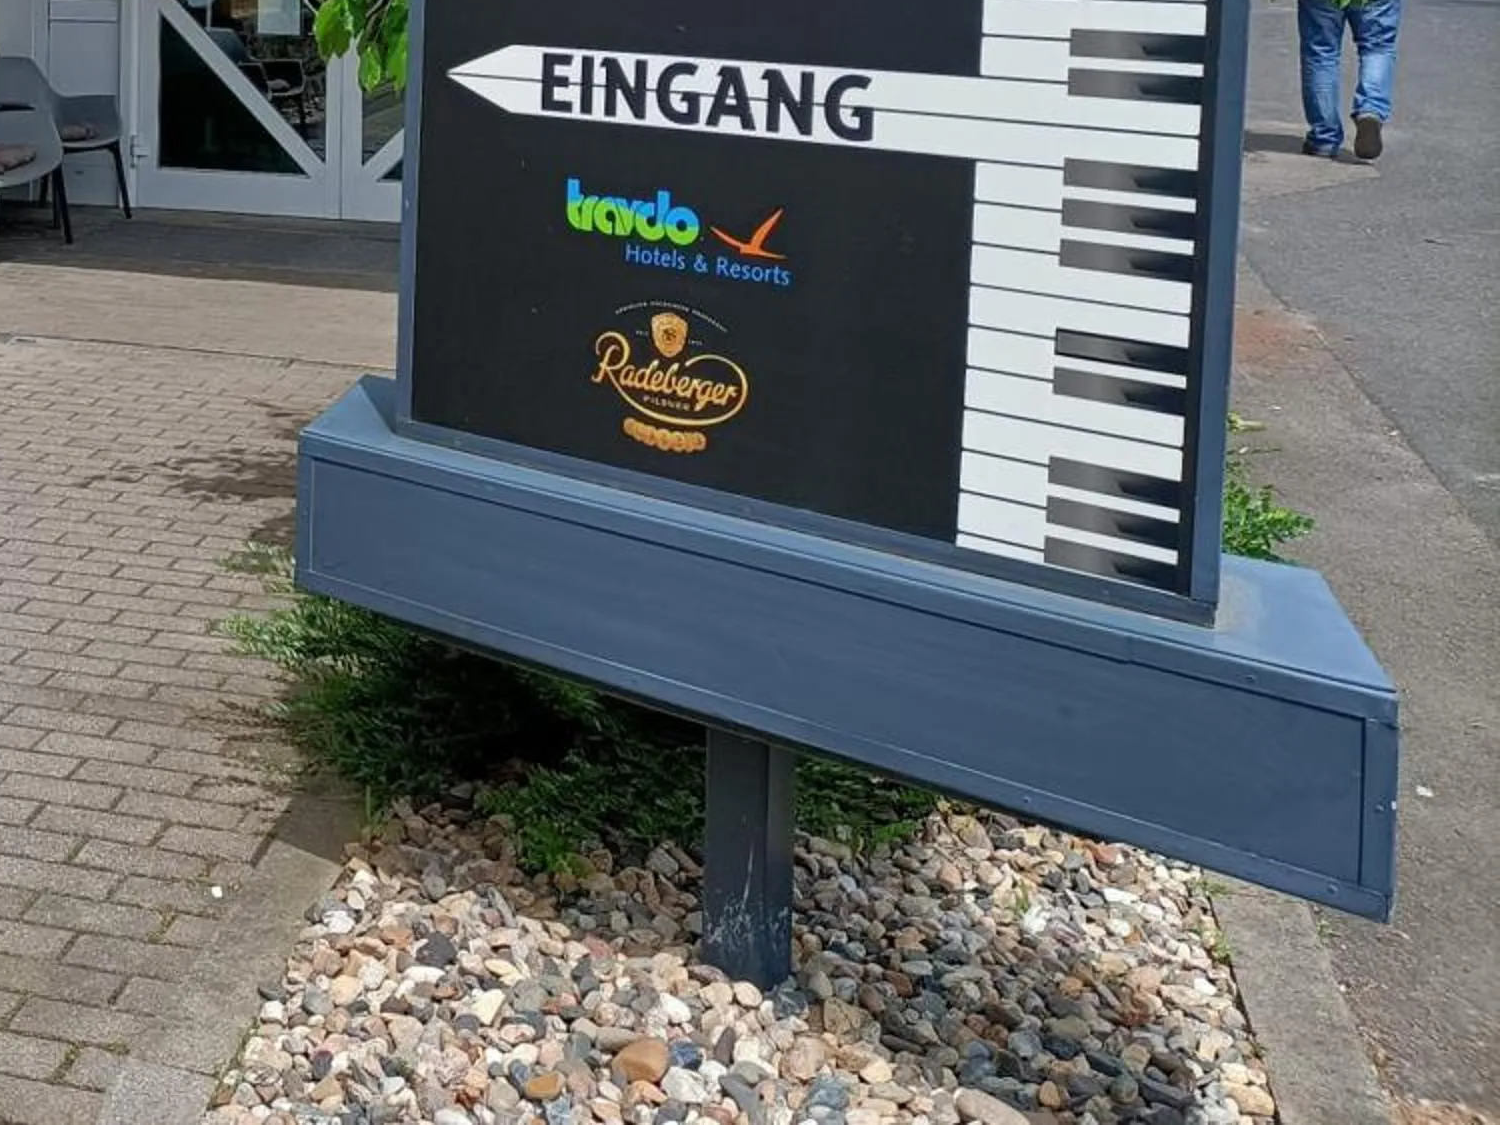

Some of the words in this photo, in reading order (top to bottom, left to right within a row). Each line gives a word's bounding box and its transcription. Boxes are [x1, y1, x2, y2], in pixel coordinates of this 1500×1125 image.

[540, 52, 875, 142] EINGANG
[625, 244, 686, 271] Hotels
[693, 254, 709, 273] &
[716, 256, 792, 286] Resorts
[591, 331, 741, 412] Radeberger
